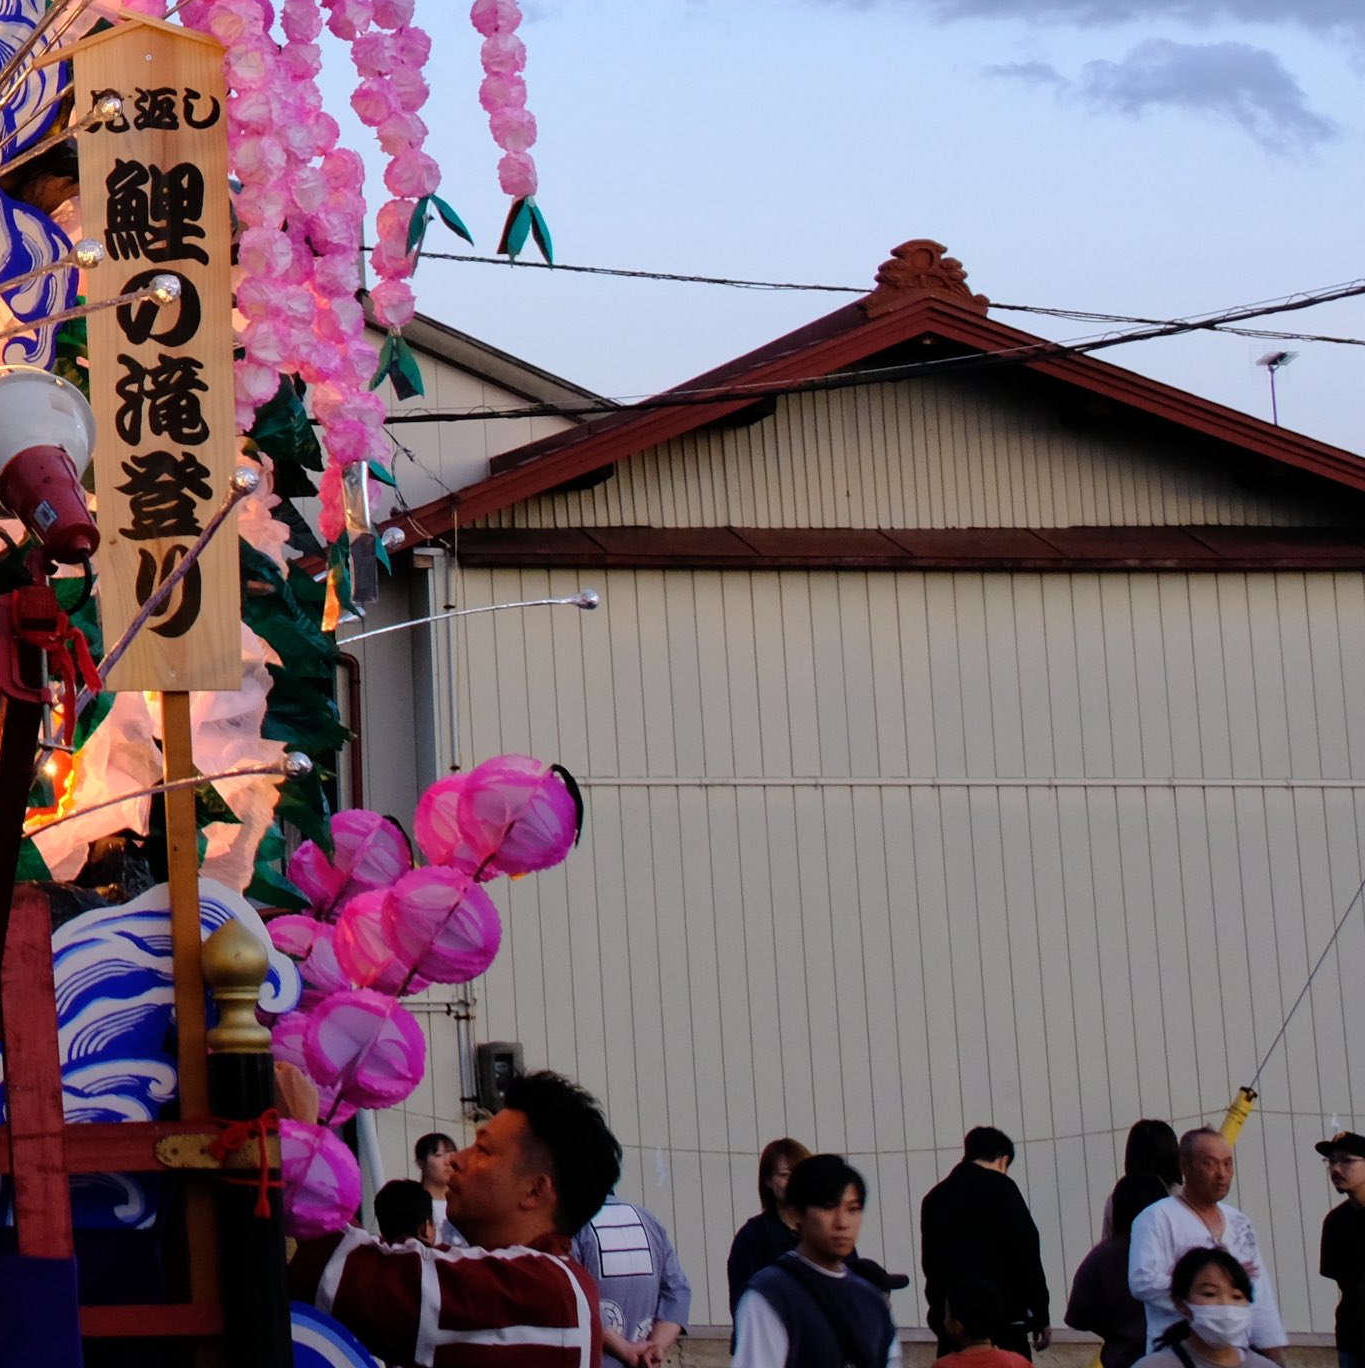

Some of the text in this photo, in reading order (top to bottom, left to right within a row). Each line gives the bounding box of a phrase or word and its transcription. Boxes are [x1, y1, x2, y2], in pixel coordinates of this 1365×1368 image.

[104, 157, 214, 639] 鯉の滝登り
